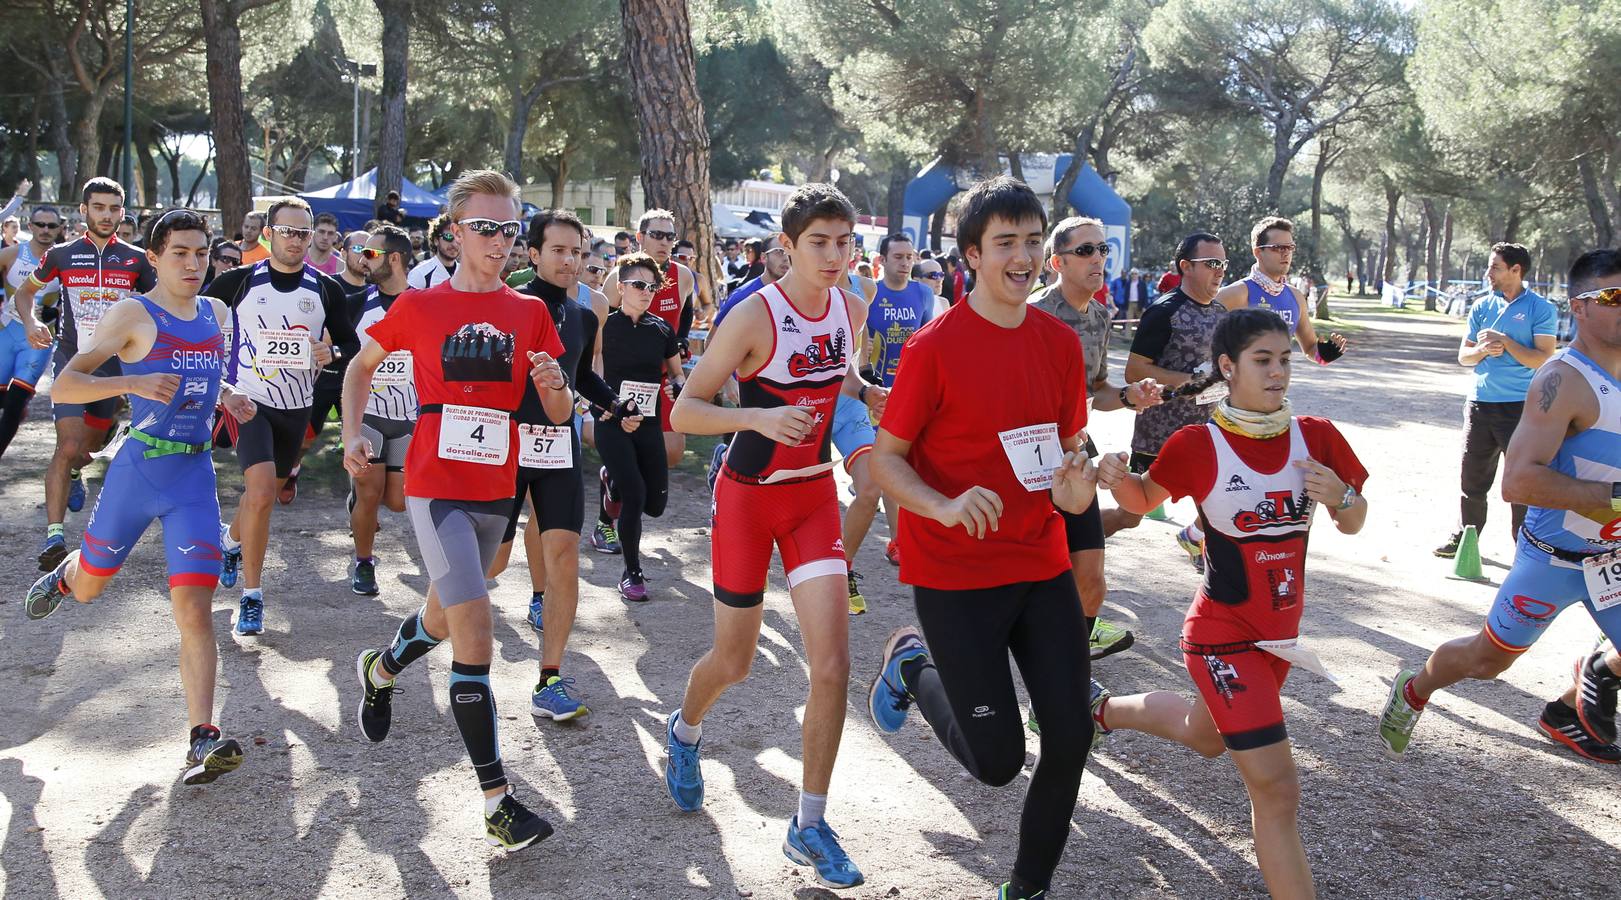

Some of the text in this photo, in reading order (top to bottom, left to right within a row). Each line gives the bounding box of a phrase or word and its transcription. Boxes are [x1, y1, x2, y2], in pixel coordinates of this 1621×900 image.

[68, 273, 97, 284] Nocedal
[105, 277, 131, 286] HUEDA
[884, 307, 917, 320] PRADA
[267, 341, 301, 355] 293
[171, 349, 220, 370] SIERRA
[377, 361, 405, 373] 292
[470, 425, 485, 443] 4
[533, 437, 555, 453] 57
[446, 447, 500, 459] dorsalia.com
[1034, 444, 1043, 466] 1
[522, 456, 566, 464] dorsalia.com
